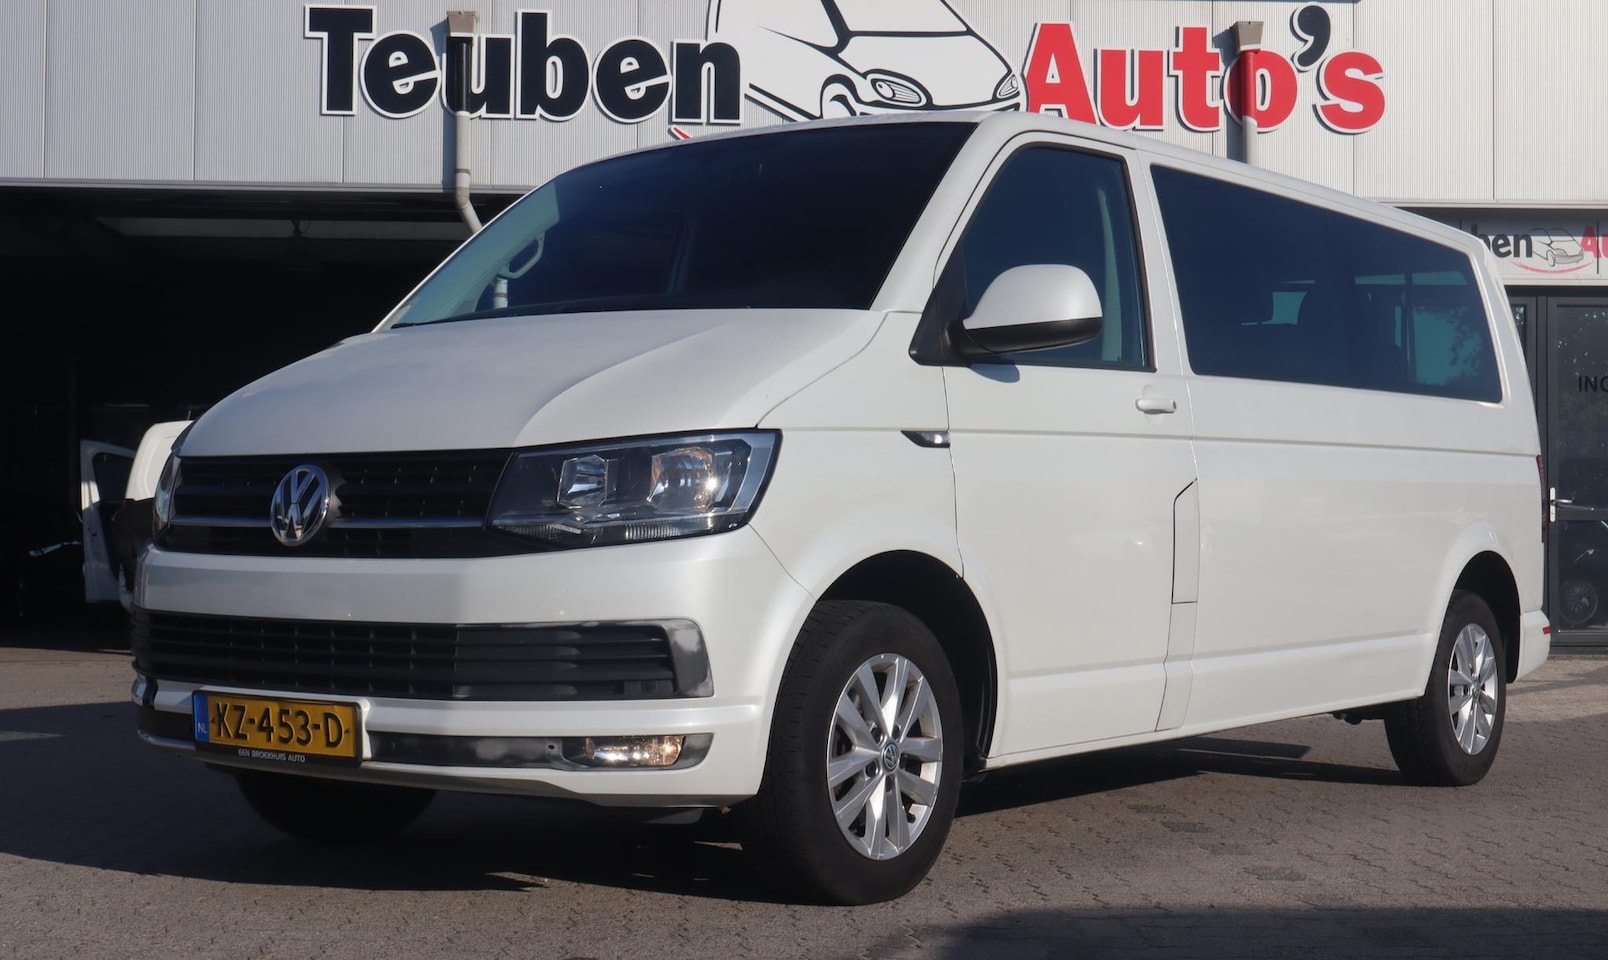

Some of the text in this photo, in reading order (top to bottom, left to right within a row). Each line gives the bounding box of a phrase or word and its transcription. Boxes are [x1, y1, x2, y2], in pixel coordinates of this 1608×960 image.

[304, 4, 1386, 133] Teuben Auto's
[197, 722, 208, 734] NL
[215, 702, 344, 748] KZ-453-D
[251, 750, 287, 761] BROEKHUIS
[288, 754, 306, 763] AUTO
